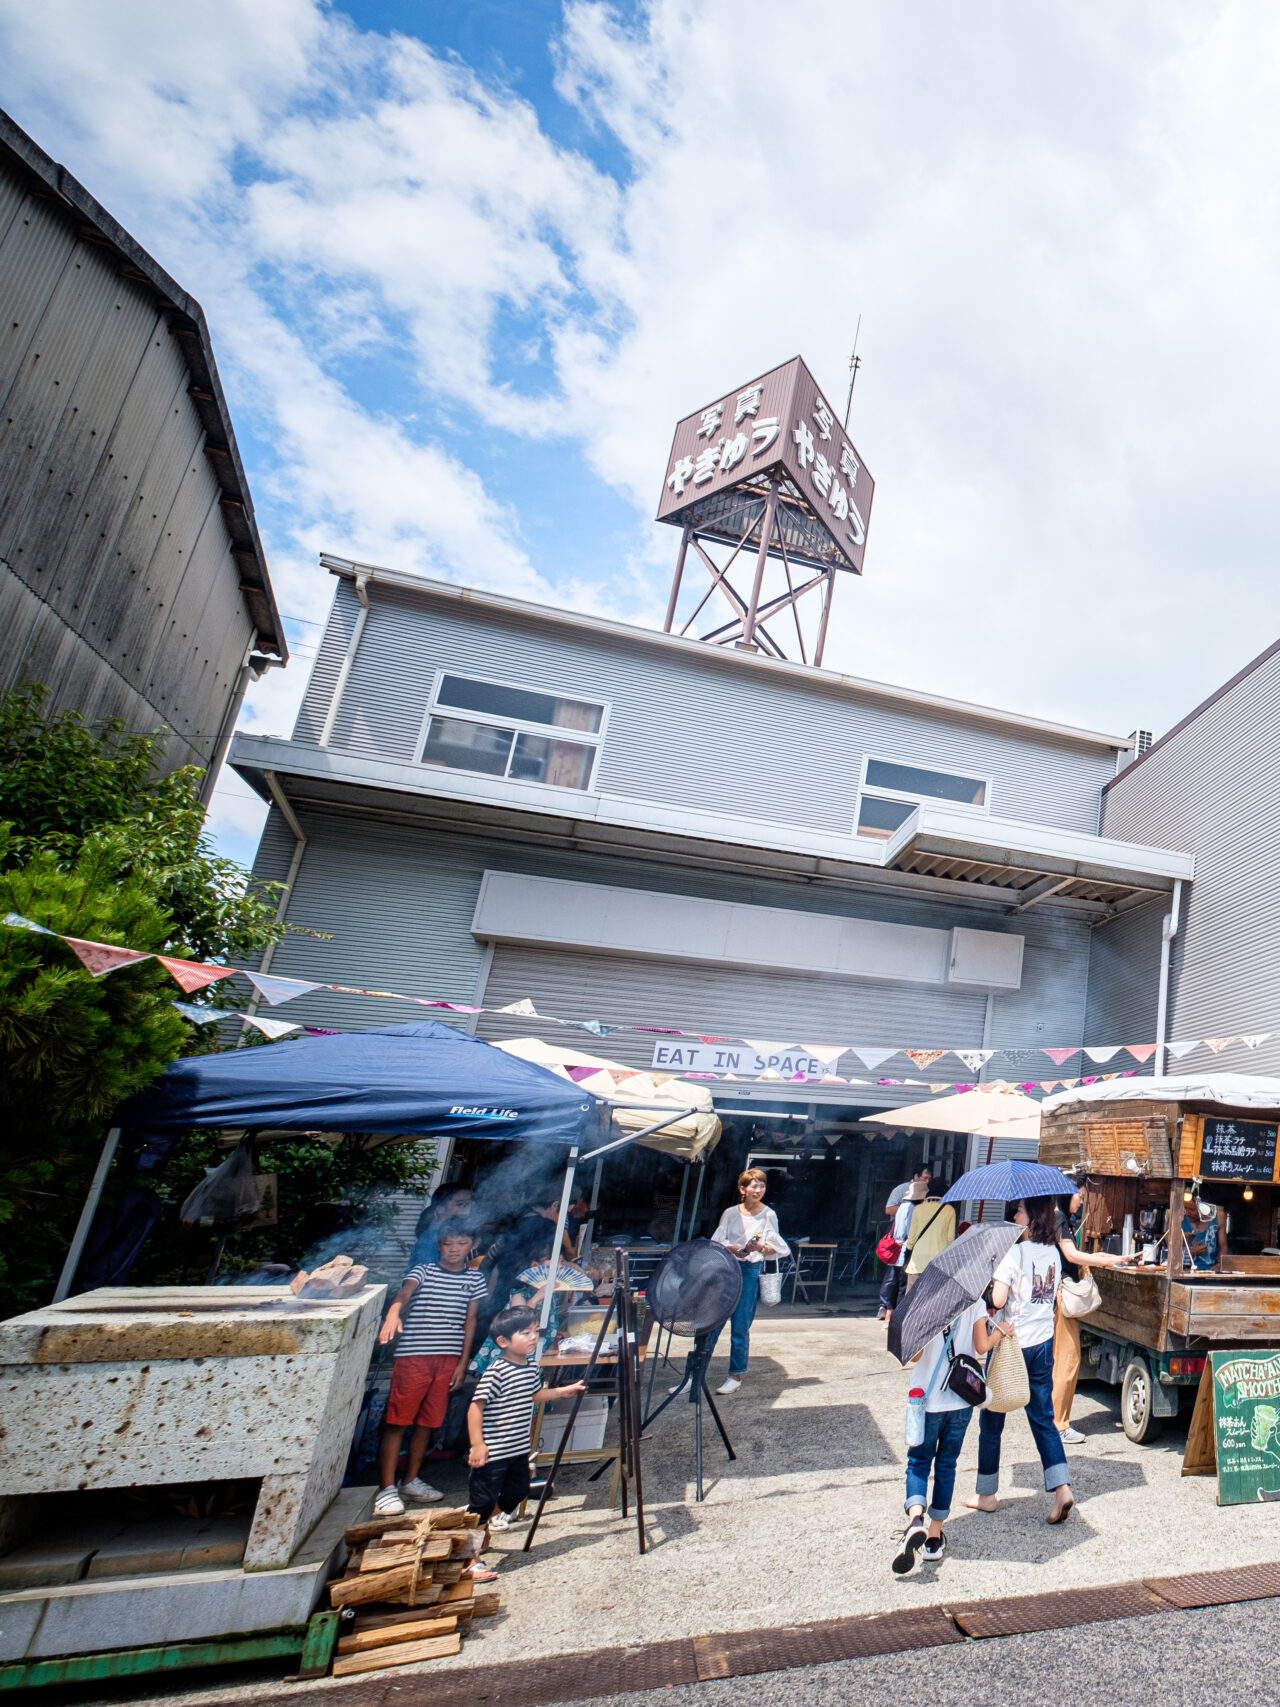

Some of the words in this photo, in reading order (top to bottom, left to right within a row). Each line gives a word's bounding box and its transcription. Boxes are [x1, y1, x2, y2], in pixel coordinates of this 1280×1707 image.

[697, 383, 764, 440] 写真
[813, 397, 860, 488] 写真
[656, 1047, 699, 1066] EAT
[713, 1051, 740, 1069] IN
[754, 1055, 819, 1074] SPACE
[490, 1108, 519, 1118] Life
[1222, 1437, 1235, 1448] 600
